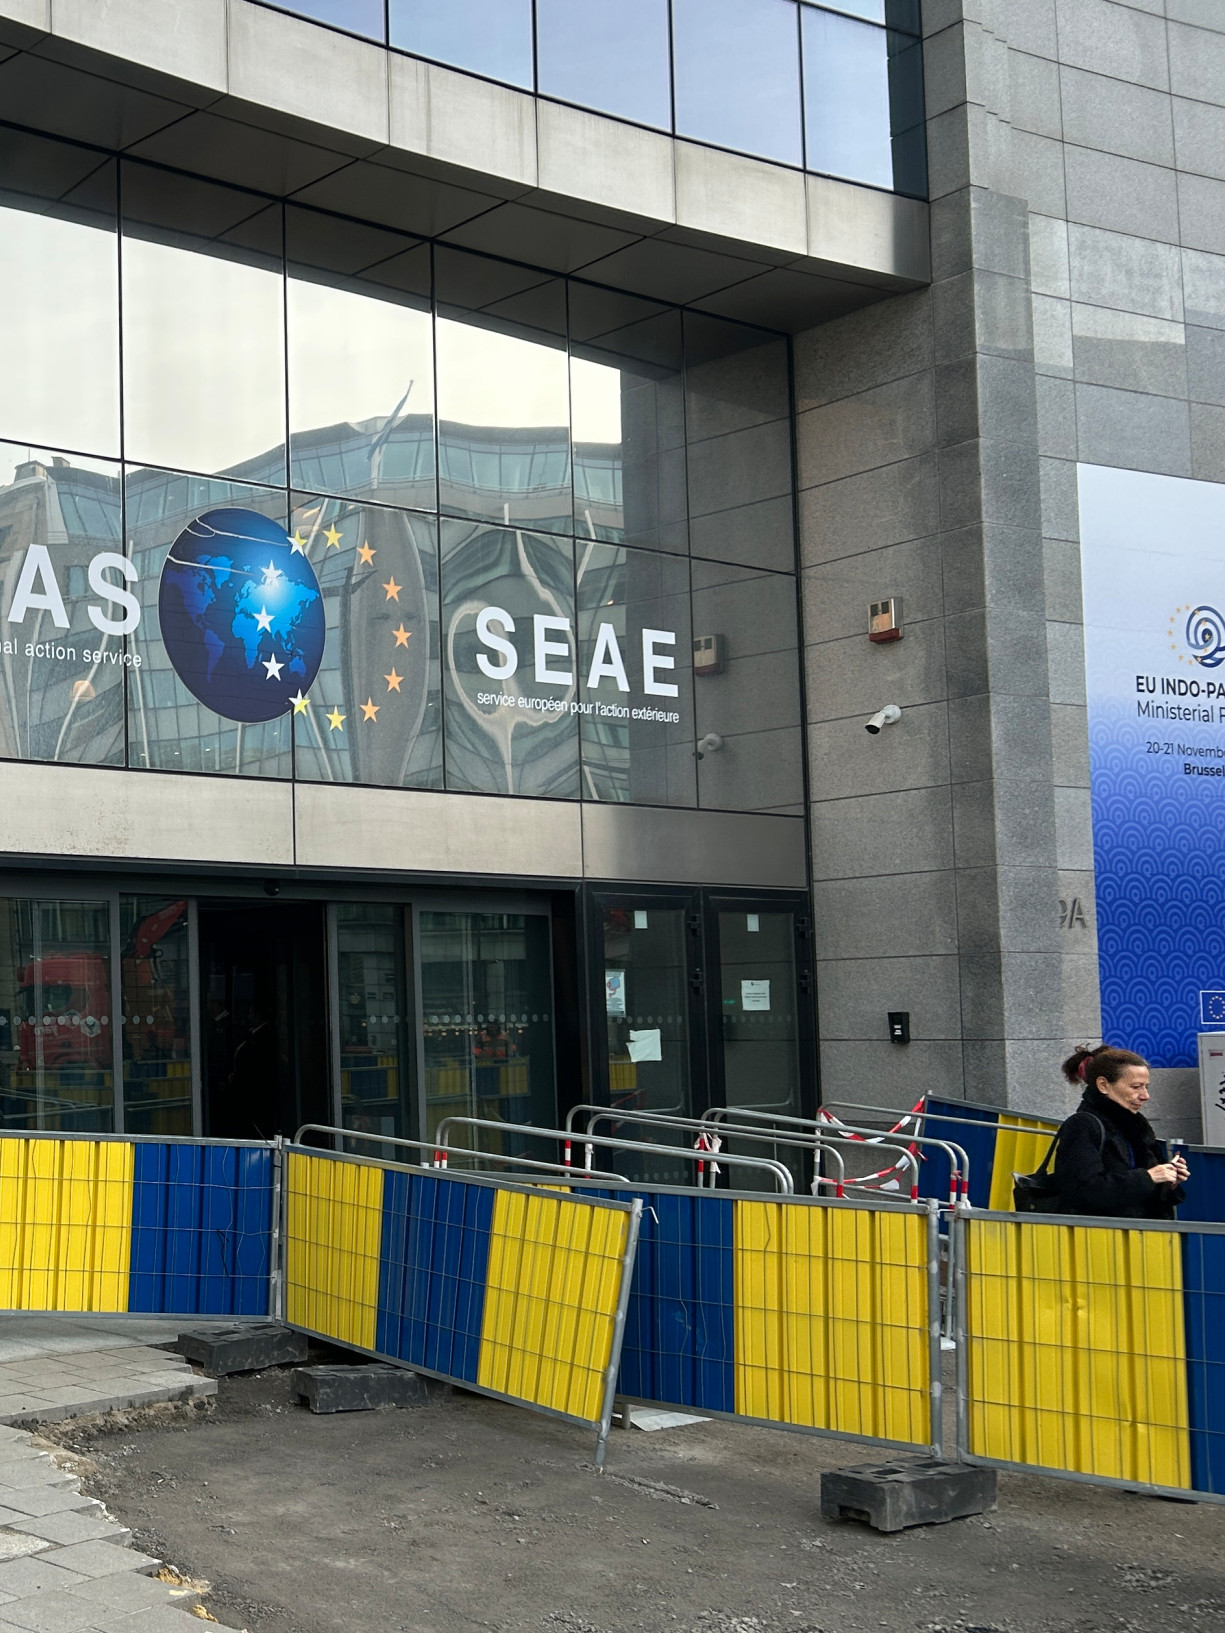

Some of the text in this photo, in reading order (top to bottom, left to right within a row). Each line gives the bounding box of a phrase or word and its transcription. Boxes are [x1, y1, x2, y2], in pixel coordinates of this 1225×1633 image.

[24, 641, 76, 661] action
[82, 648, 143, 668] service
[476, 606, 679, 698] SEAE
[1136, 675, 1156, 694] EU
[477, 691, 680, 723] service européen pour l'action extérieure
[1137, 699, 1214, 723] Ministerial
[1146, 741, 1225, 759] 20-21 Novemb
